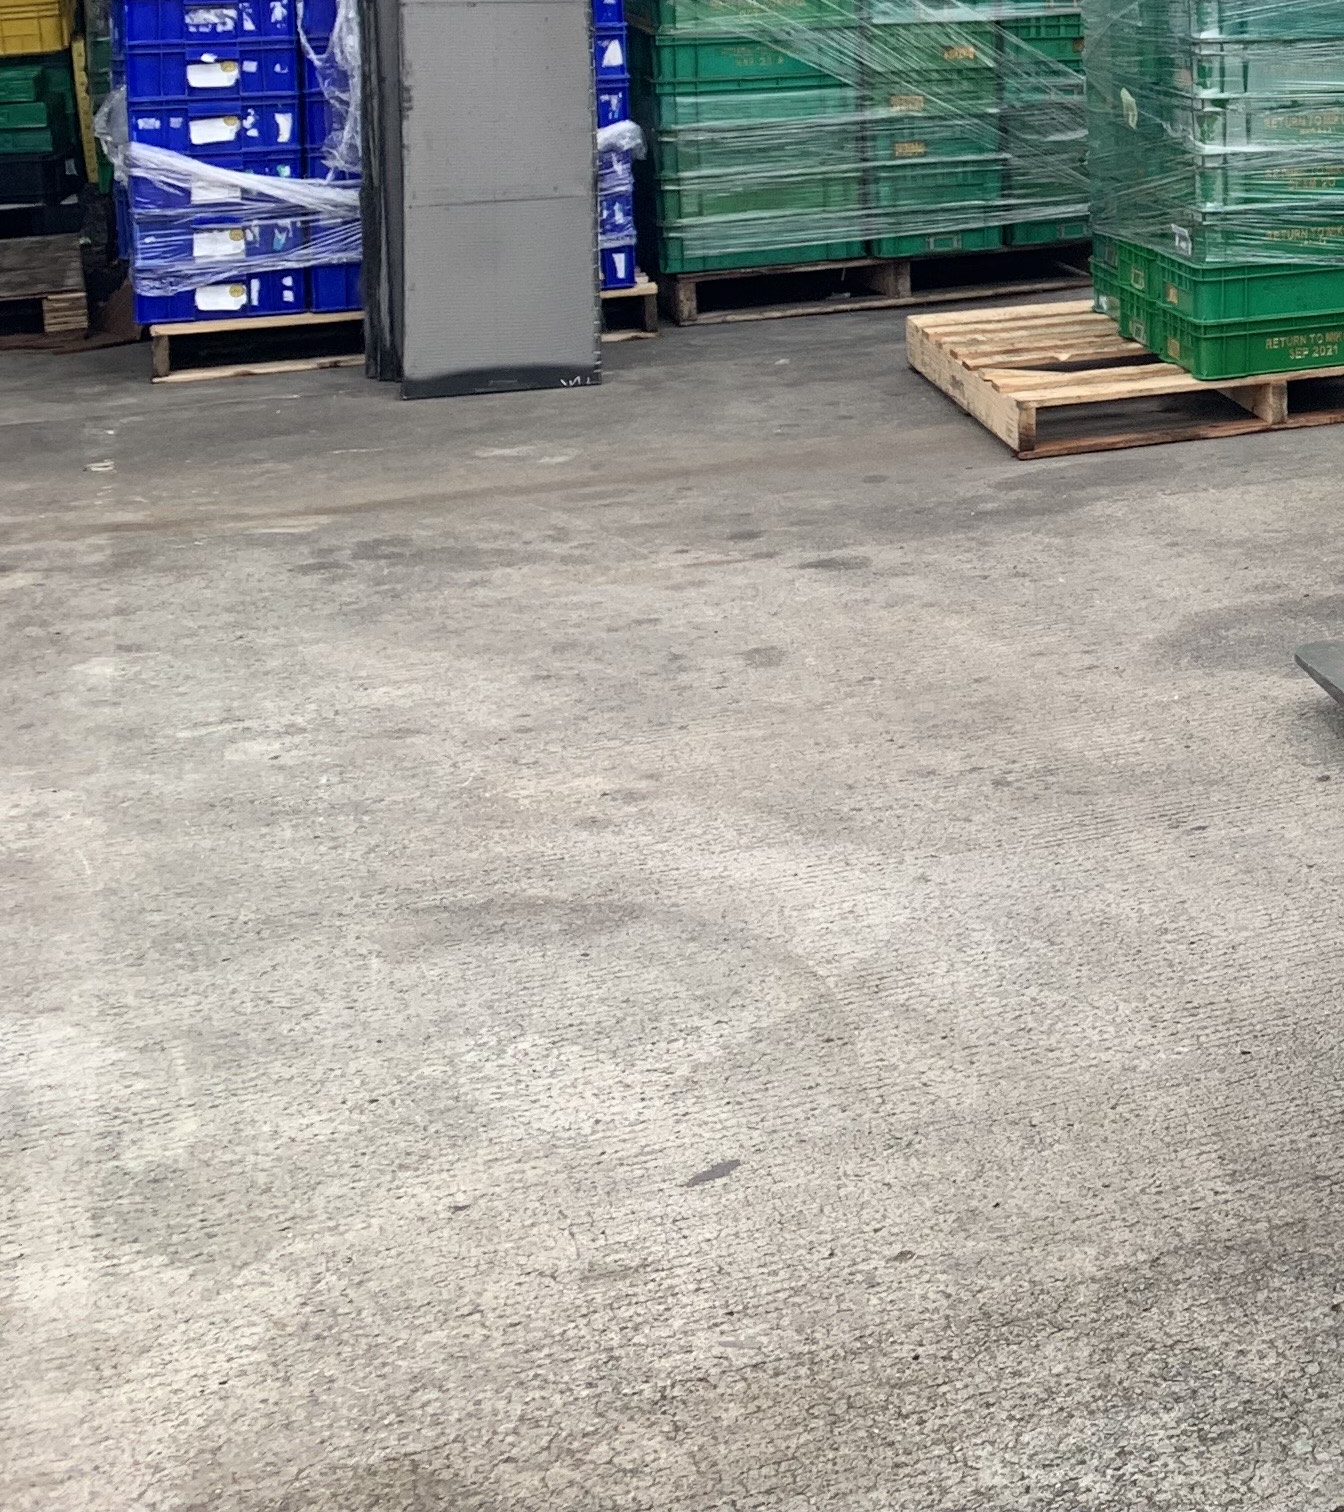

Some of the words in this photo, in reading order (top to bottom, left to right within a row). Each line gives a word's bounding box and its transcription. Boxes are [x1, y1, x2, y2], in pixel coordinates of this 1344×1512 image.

[1265, 336, 1307, 350] RETURN
[1309, 333, 1324, 344] TO
[1289, 347, 1309, 360] SEP
[1312, 344, 1339, 358] 2021
